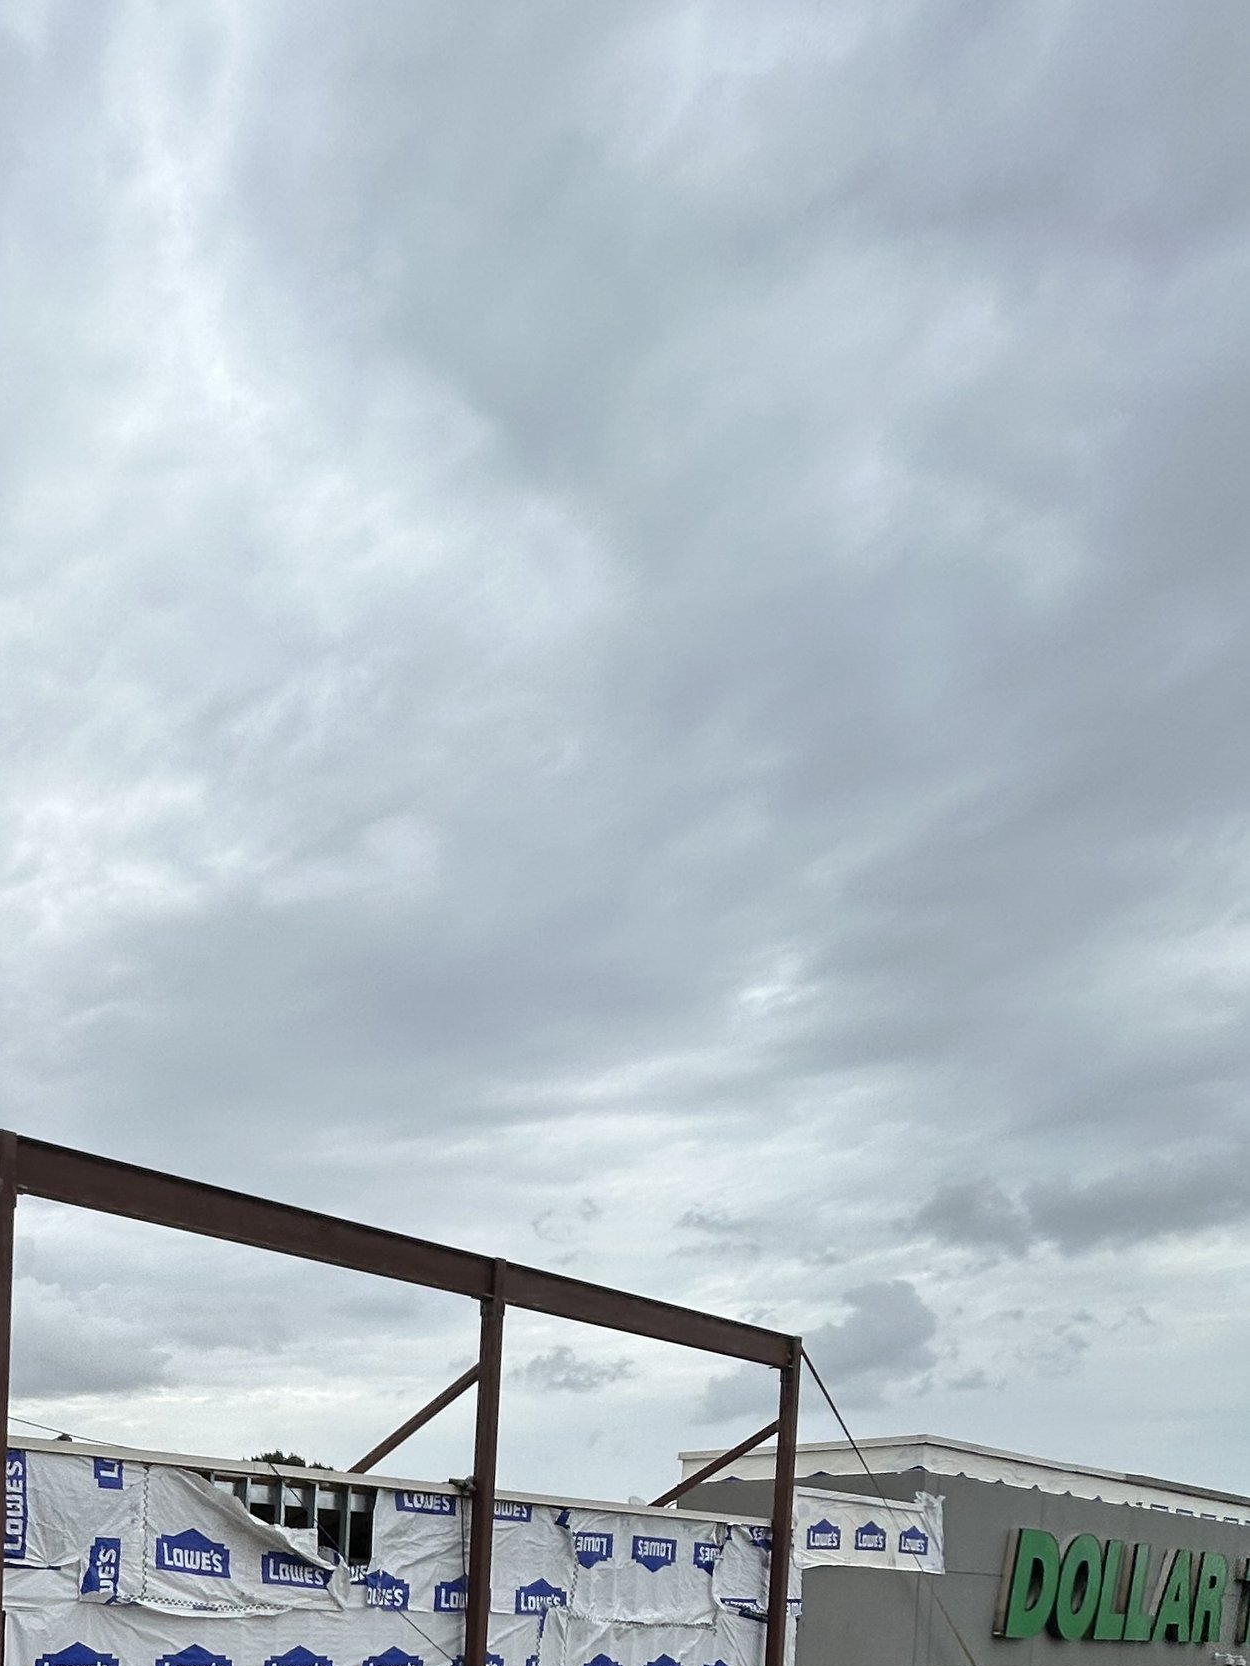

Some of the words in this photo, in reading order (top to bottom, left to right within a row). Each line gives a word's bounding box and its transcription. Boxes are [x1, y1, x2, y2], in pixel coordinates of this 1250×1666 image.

[163, 1541, 223, 1573] LOWE'S
[638, 1538, 672, 1560] LOWE'S
[994, 1527, 1228, 1643] DOLLAR
